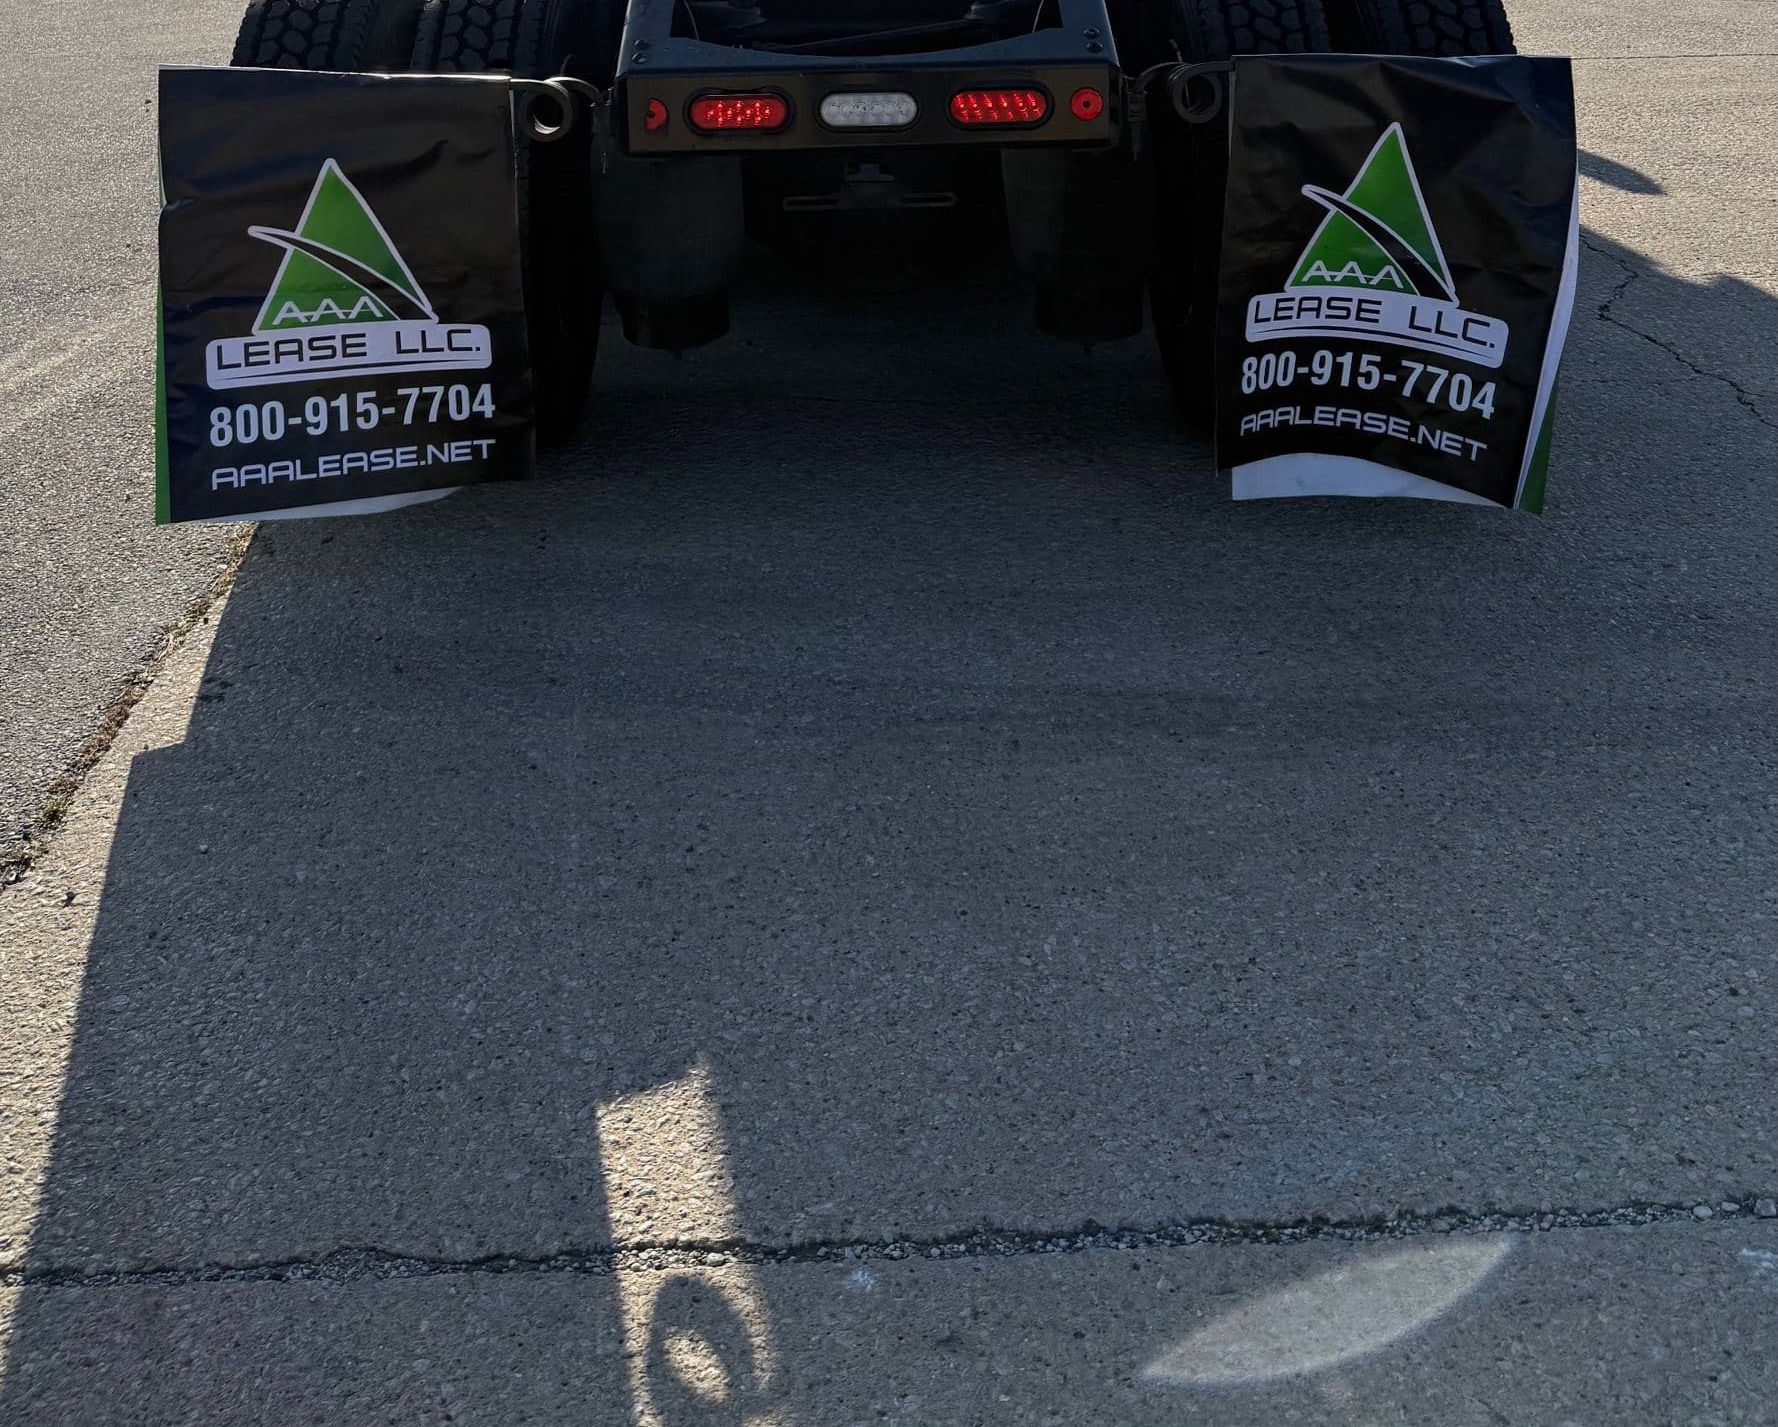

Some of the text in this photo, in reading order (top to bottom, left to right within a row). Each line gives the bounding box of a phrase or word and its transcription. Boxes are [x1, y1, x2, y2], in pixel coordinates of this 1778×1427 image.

[1302, 260, 1404, 289] AAA
[272, 295, 384, 326] AAA
[1253, 296, 1496, 349] LEASE LLC.
[217, 328, 481, 371] LEASE LLC.
[1241, 350, 1496, 420] 800-915-7704
[210, 383, 496, 448] 800-915-7704
[1240, 406, 1488, 461] AAALEASE.NET
[211, 438, 496, 491] AAALEASE.NET
